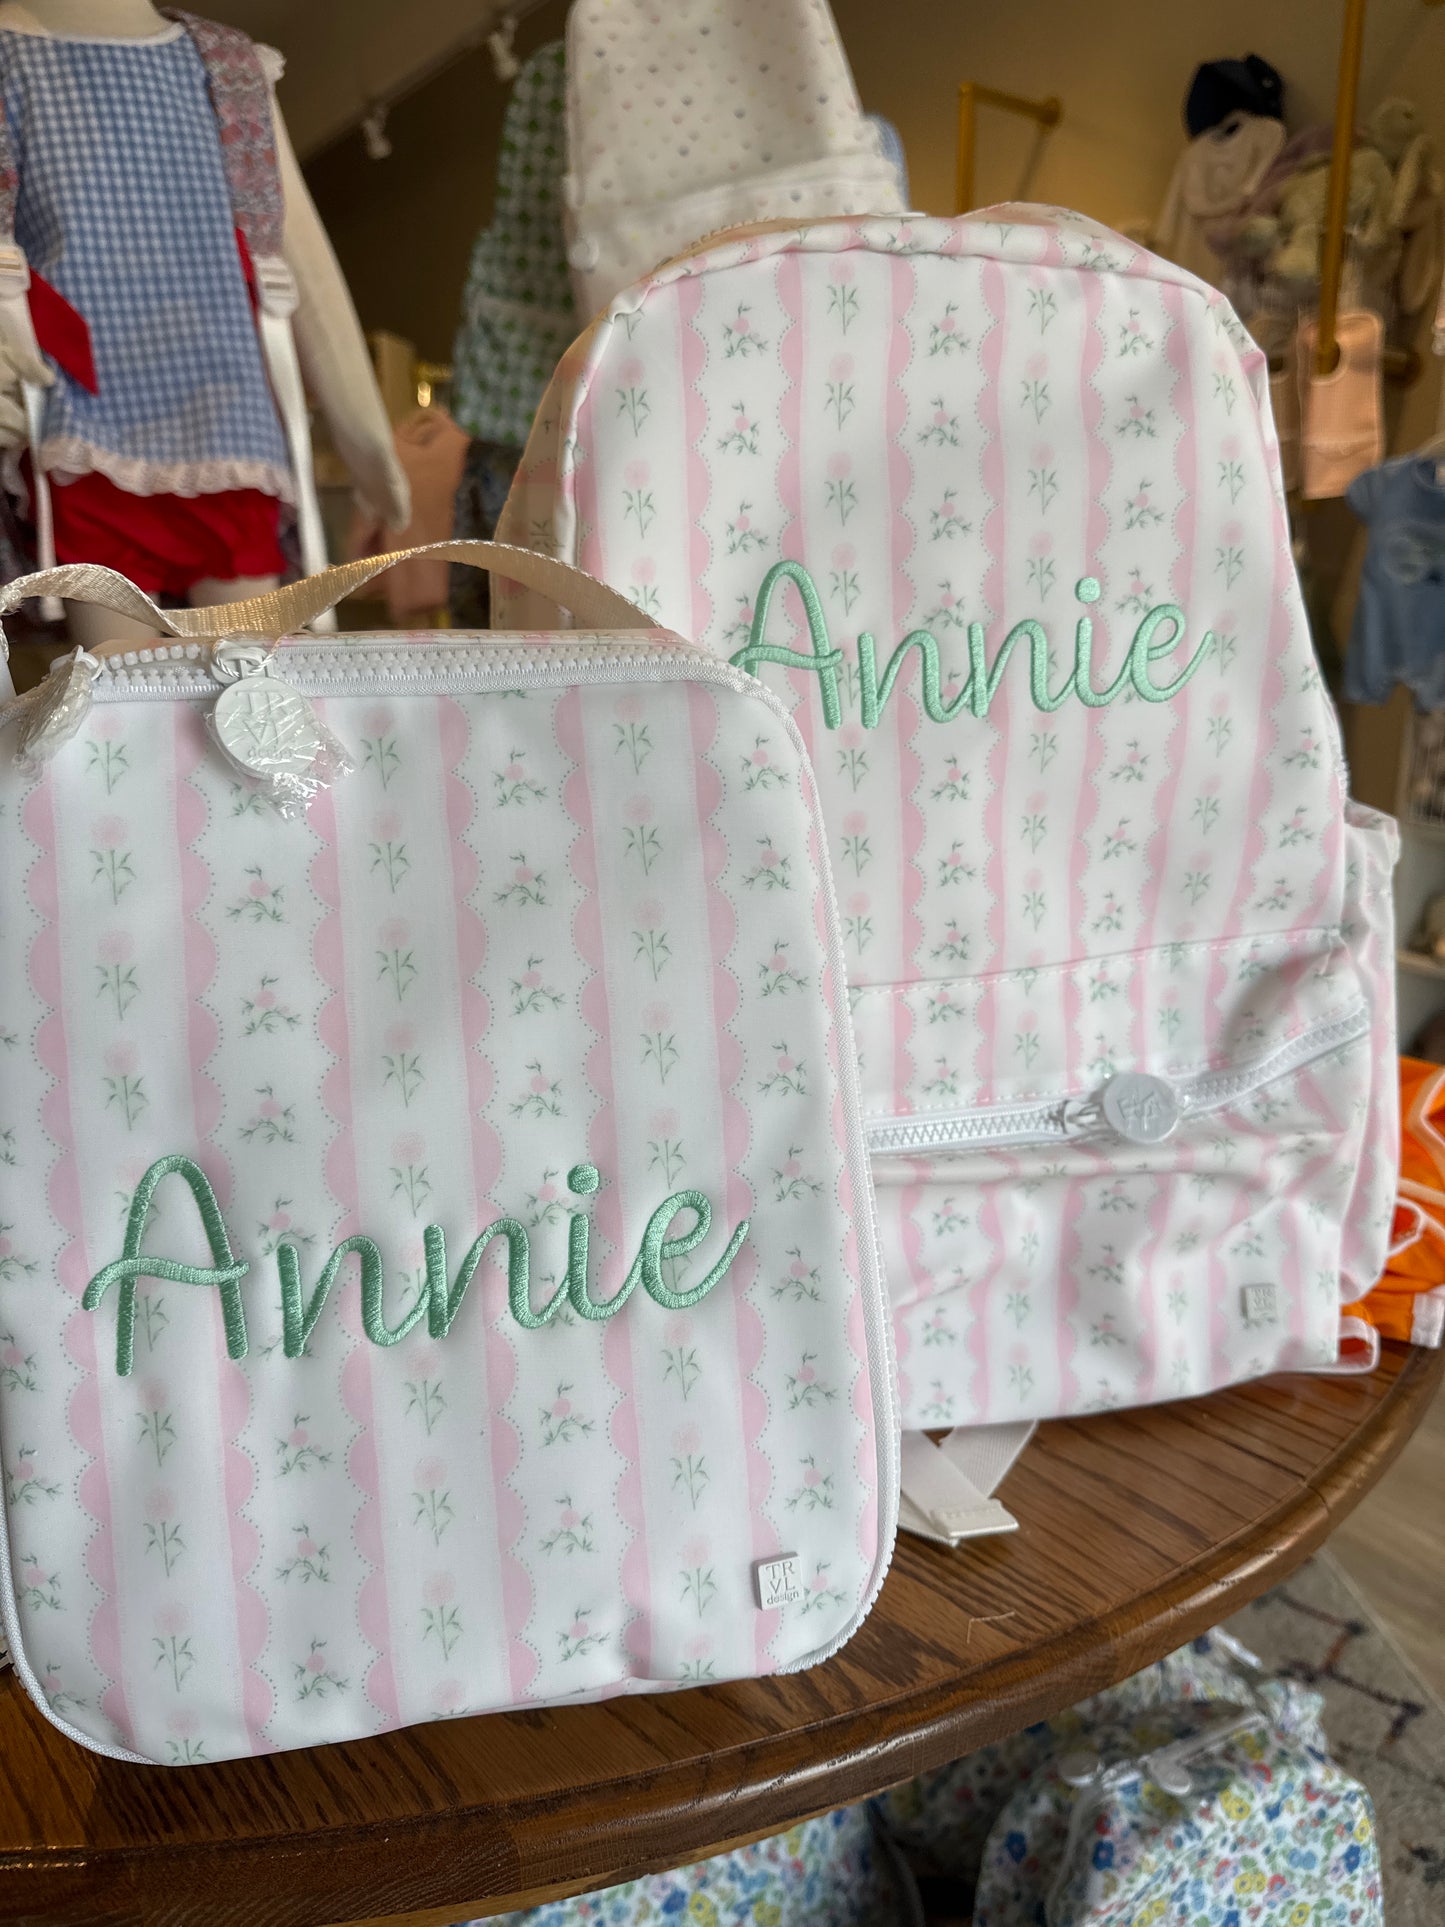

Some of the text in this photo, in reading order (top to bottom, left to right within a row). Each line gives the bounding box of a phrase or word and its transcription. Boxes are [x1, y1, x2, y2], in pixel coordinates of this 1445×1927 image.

[729, 560, 1215, 731] Annie
[83, 1154, 750, 1378] Annie
[765, 1560, 795, 1579] TR
[770, 1577, 796, 1594] VL
[766, 1591, 799, 1604] design
